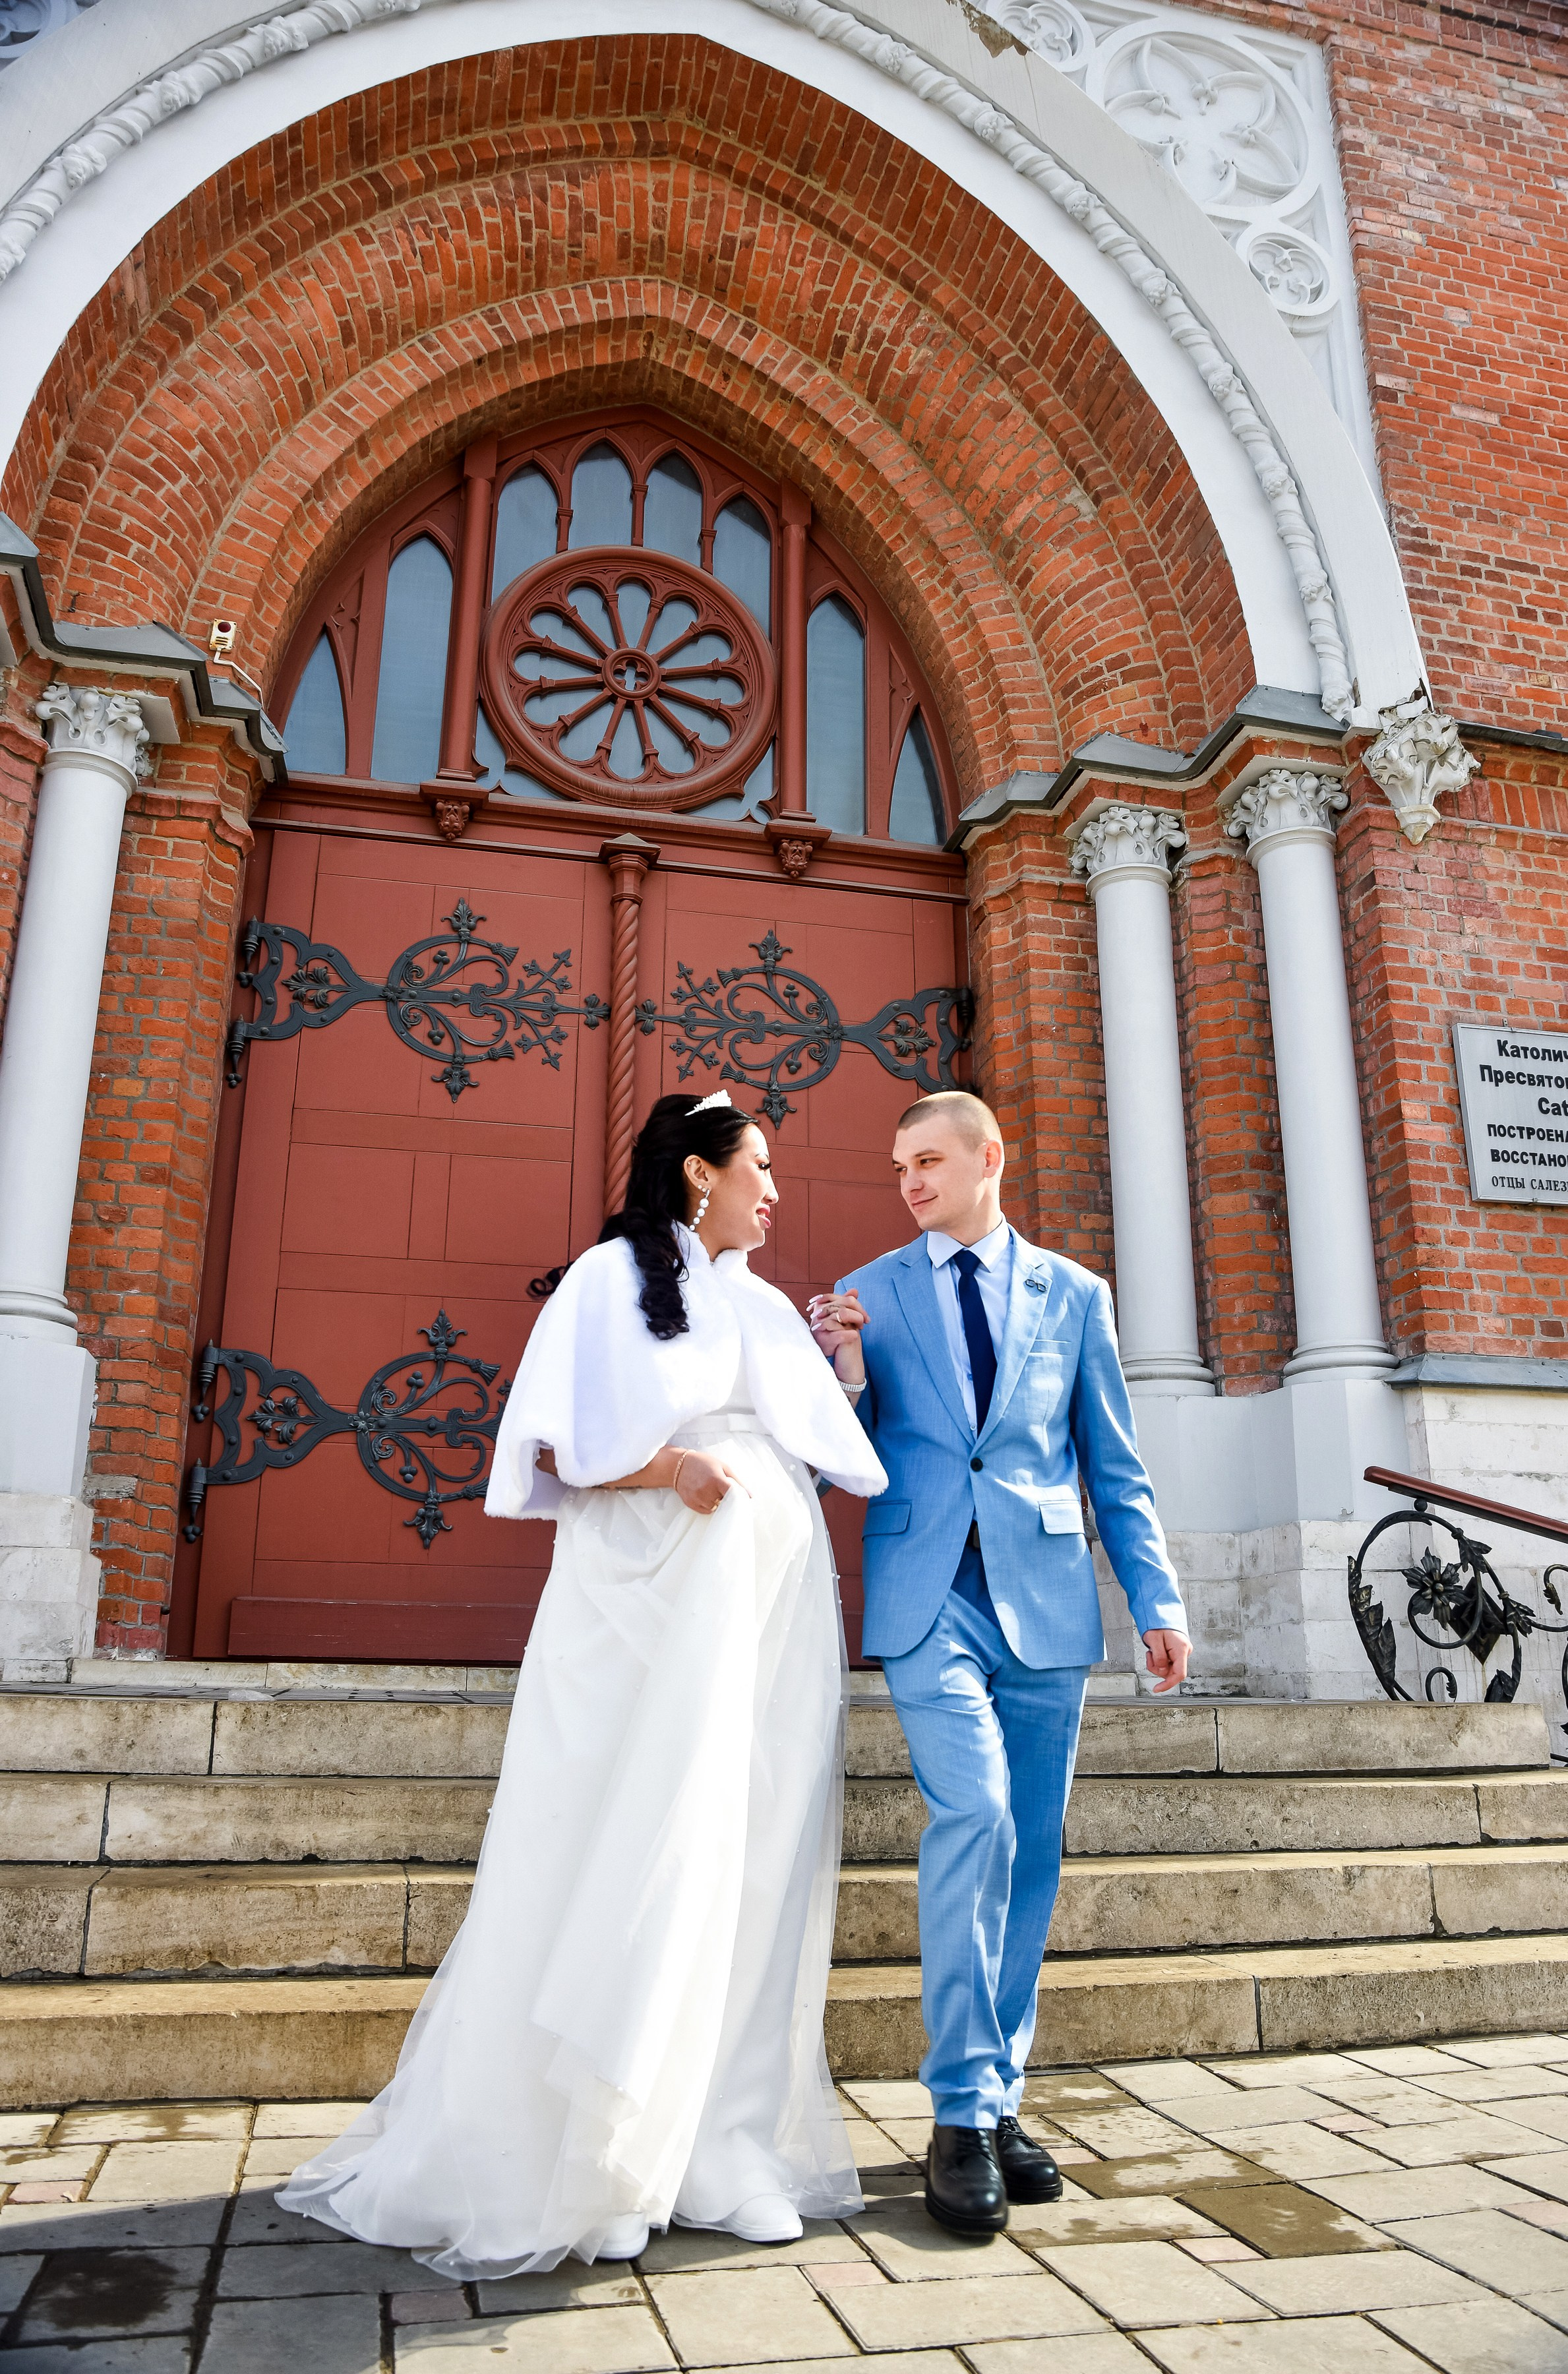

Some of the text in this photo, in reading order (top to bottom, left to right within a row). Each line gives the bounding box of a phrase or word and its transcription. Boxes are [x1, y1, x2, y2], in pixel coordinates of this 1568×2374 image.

[1490, 1149, 1568, 1168] ВОССТАНО
[1492, 1176, 1568, 1192] ОТЦЫ САЛЕЗ
